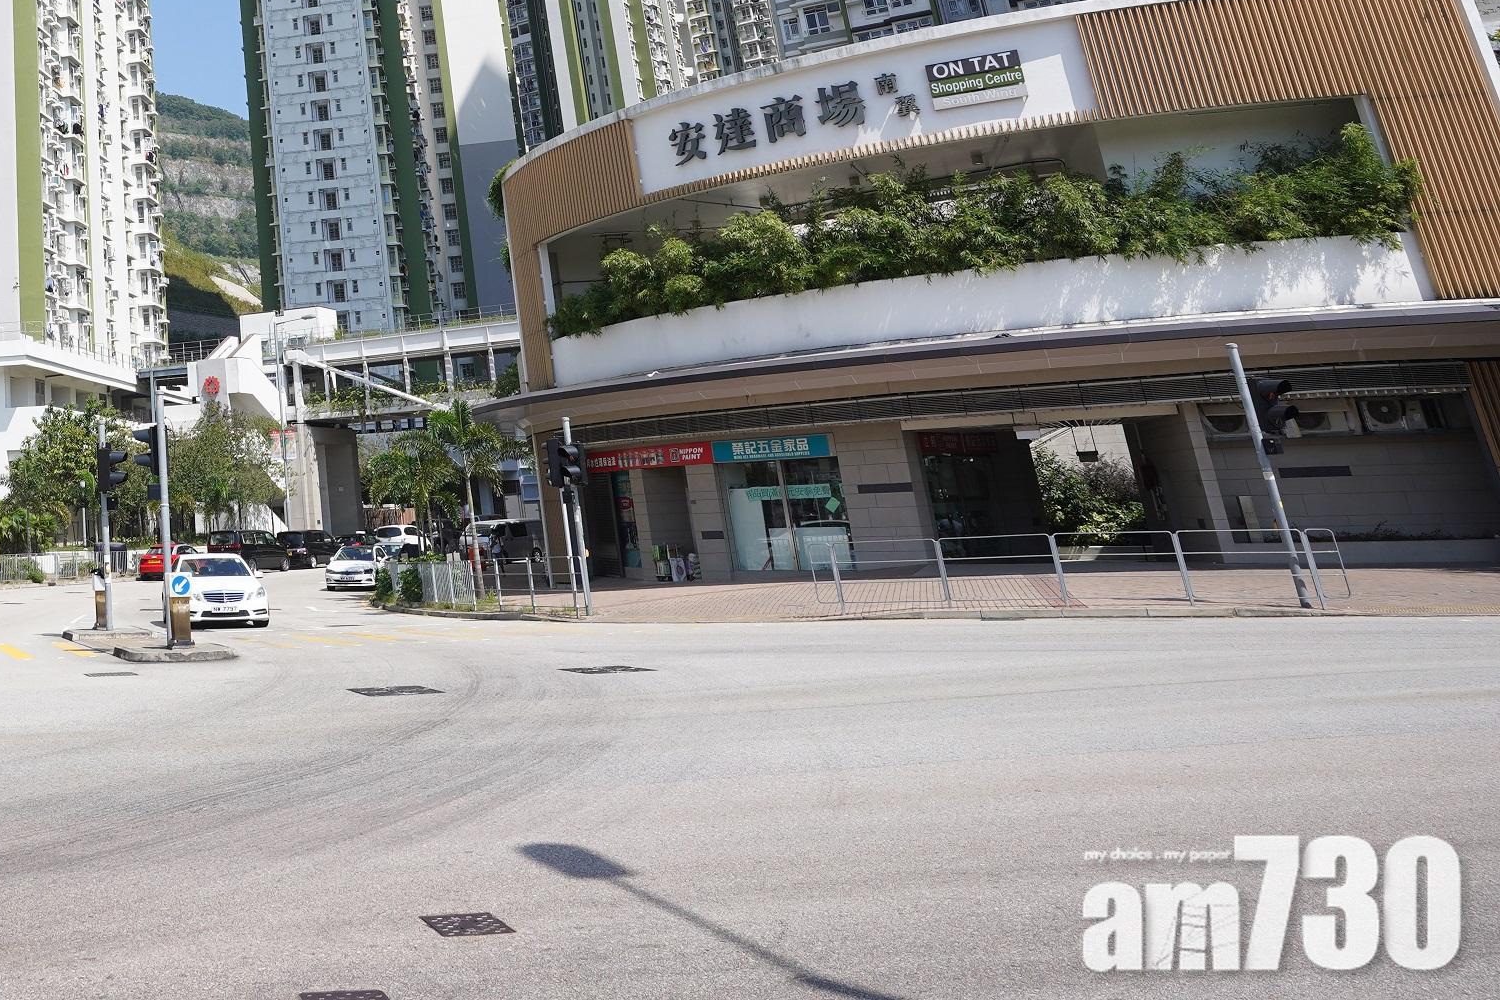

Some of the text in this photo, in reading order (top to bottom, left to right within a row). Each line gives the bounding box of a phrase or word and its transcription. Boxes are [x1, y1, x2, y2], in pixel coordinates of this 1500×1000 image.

[932, 52, 1011, 79] ON TAT
[931, 70, 1022, 94] Shopping Centre
[679, 447, 703, 455] NIPPON
